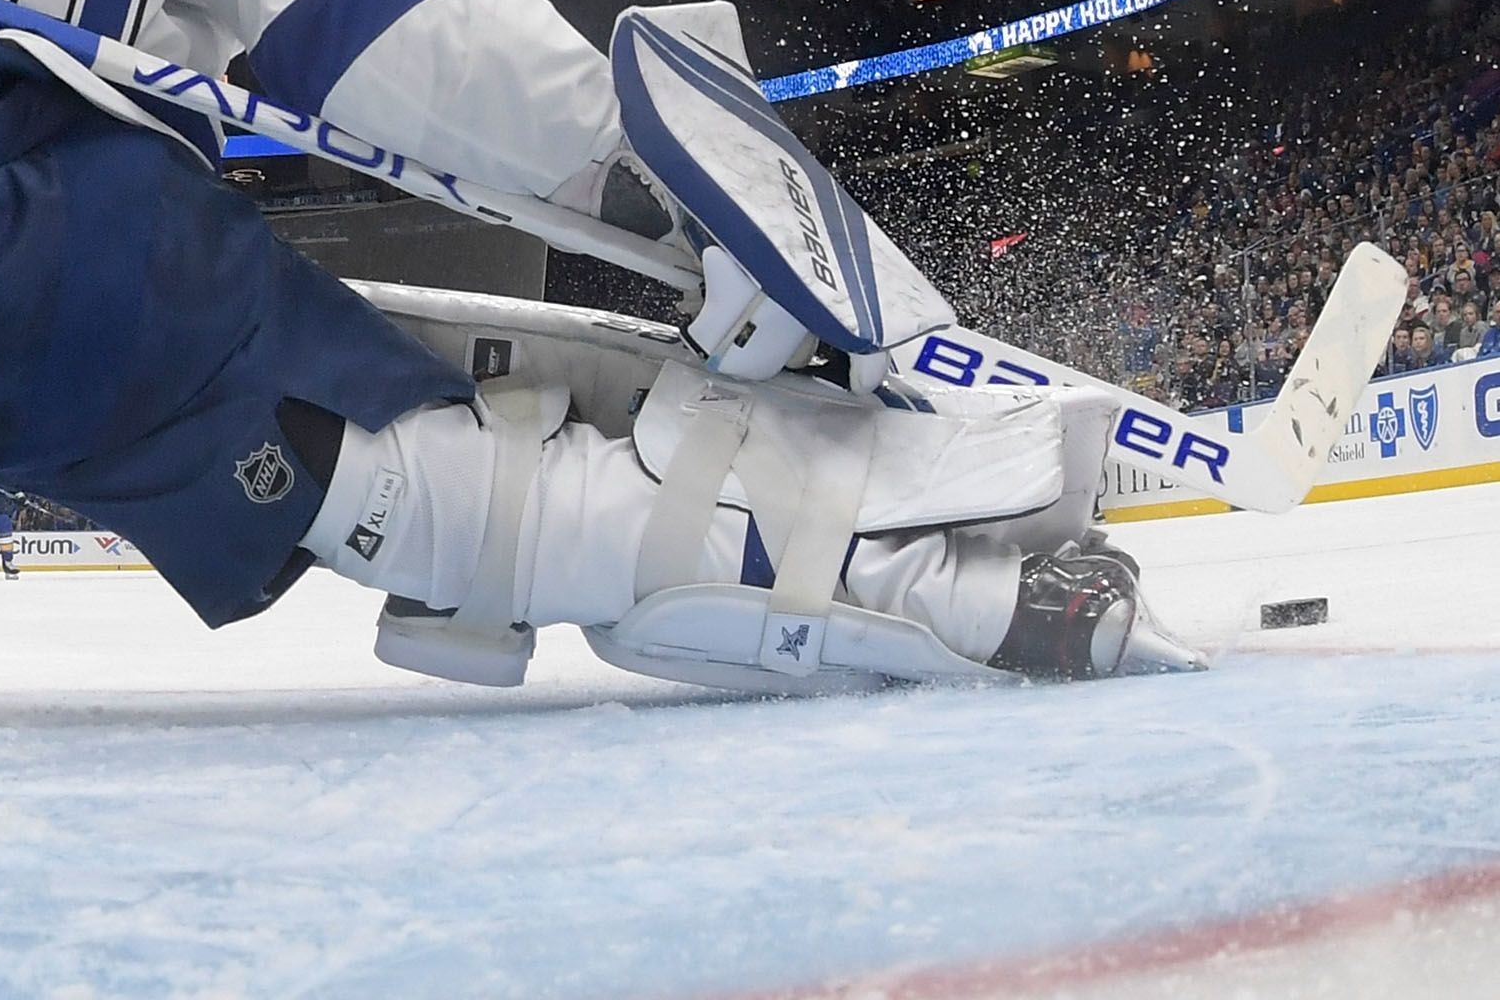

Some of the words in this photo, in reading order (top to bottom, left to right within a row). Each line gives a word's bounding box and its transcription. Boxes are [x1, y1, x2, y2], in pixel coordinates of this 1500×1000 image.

[1002, 9, 1075, 47] HAPPY
[255, 459, 277, 497] NHL
[367, 509, 387, 530] XL
